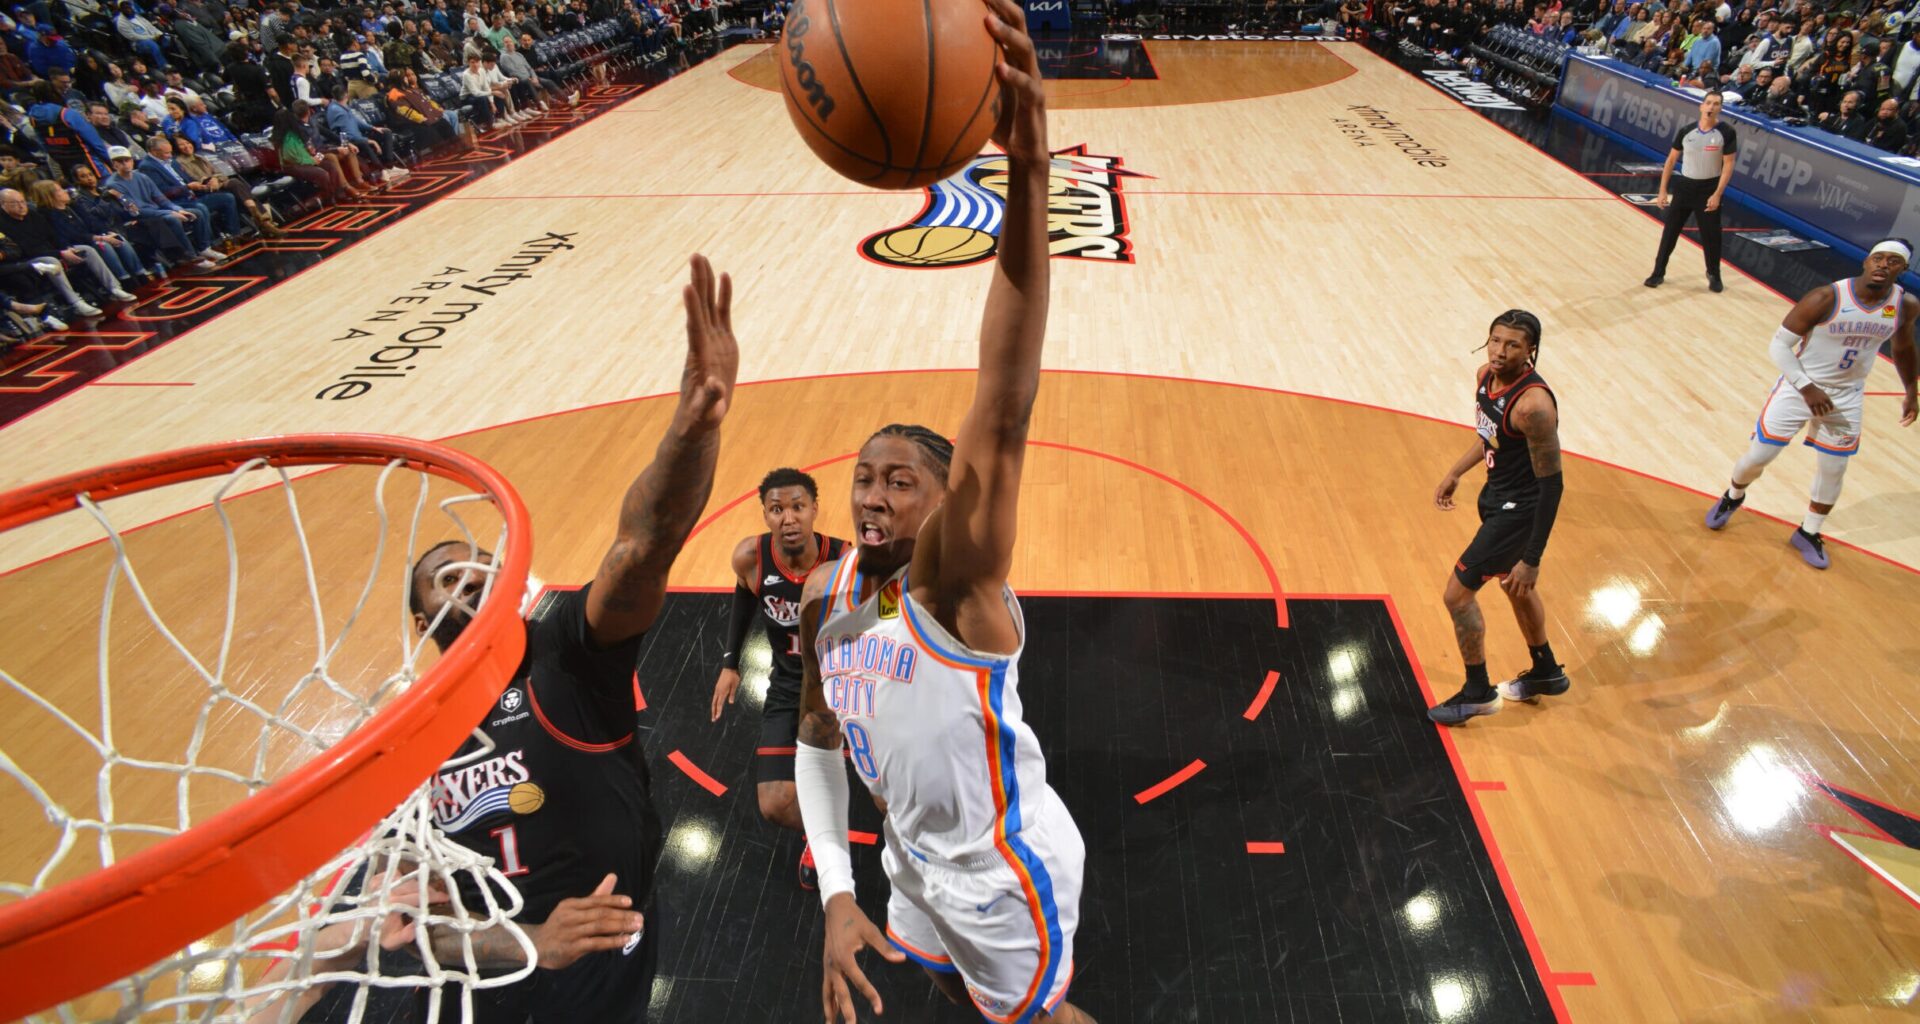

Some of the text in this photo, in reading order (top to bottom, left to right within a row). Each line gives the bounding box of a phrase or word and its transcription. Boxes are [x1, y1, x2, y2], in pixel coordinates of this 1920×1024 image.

[1330, 117, 1376, 148] ARENA
[1346, 104, 1451, 168] xfinity mobile
[1618, 91, 1674, 138] 76ERS
[1752, 149, 1813, 196] APP
[315, 231, 579, 401] xfinity mobile
[331, 265, 469, 342] ARENA
[1838, 349, 1859, 370] 5
[1842, 335, 1873, 348] CITY
[786, 633, 802, 656] 1
[492, 711, 530, 727] crypto.com
[830, 675, 877, 719] CITY
[843, 718, 880, 783] 8
[489, 823, 531, 878] 1
